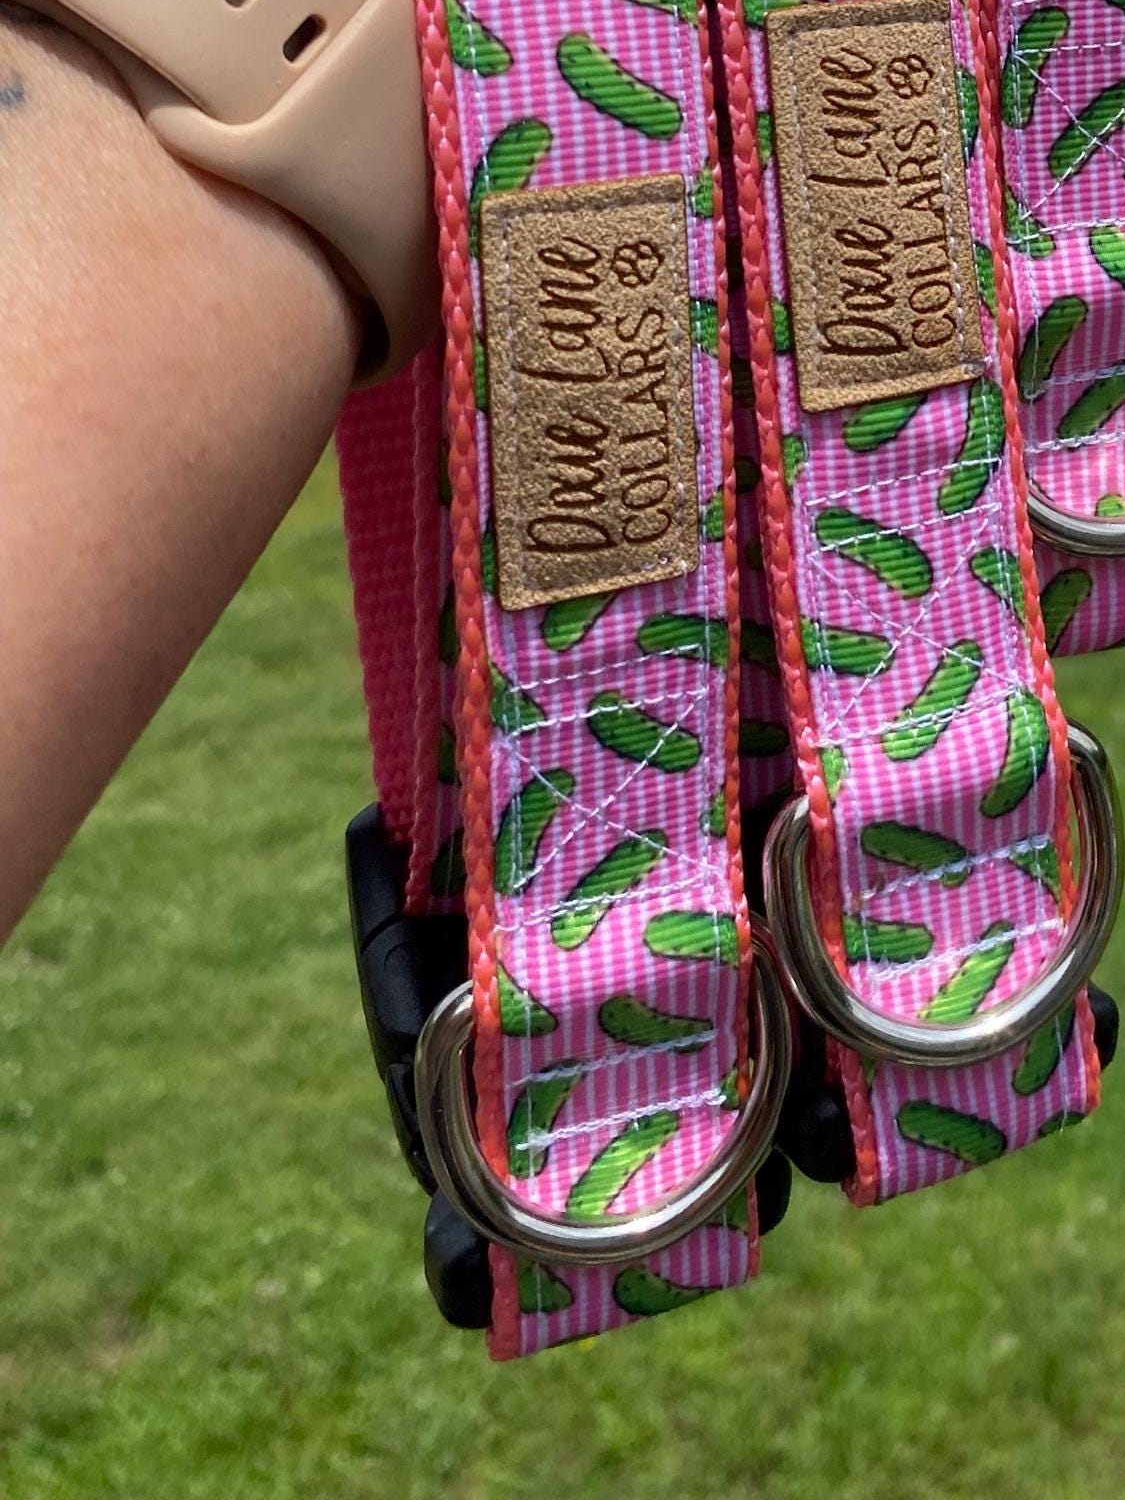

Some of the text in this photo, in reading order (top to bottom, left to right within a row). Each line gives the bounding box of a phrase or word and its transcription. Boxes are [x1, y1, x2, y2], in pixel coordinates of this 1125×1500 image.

[807, 47, 892, 187] Lane
[514, 236, 611, 382] Lane
[894, 119, 957, 349] COLLARS
[616, 306, 672, 545] COLLARS
